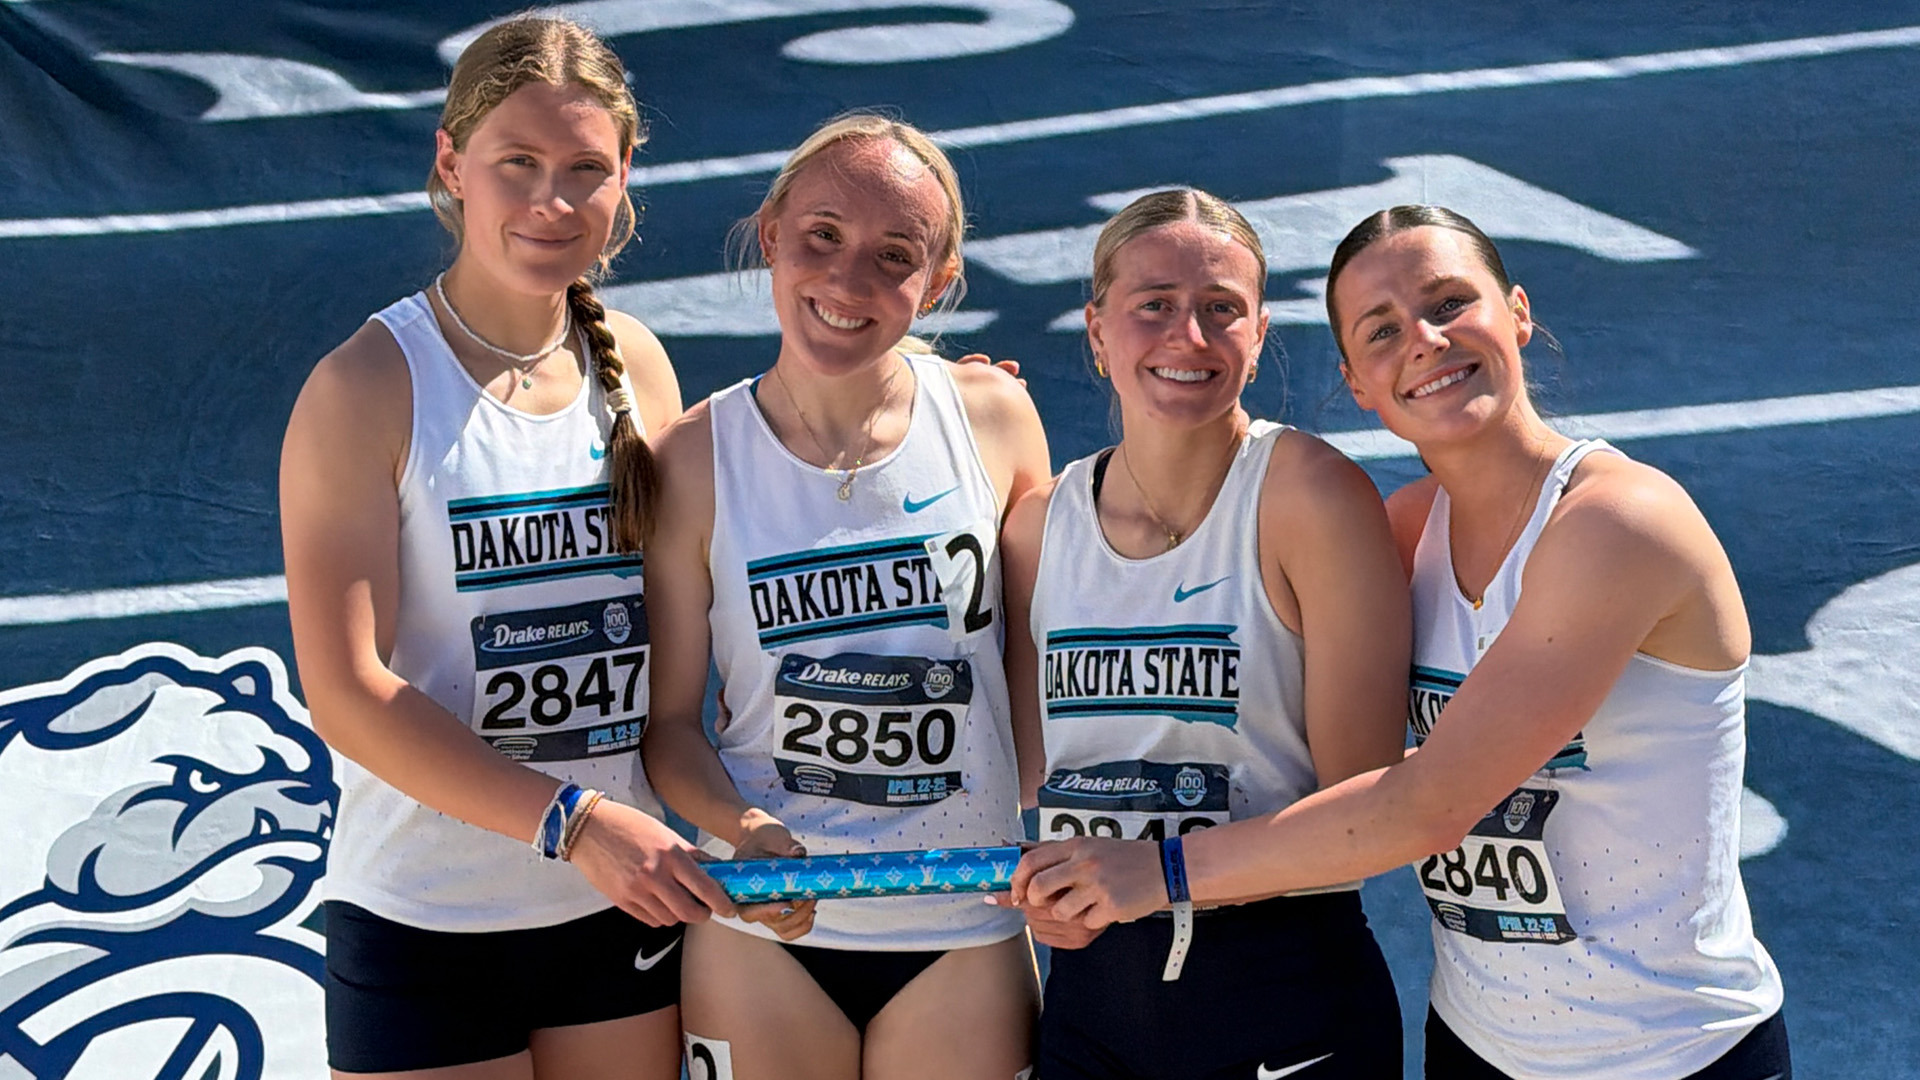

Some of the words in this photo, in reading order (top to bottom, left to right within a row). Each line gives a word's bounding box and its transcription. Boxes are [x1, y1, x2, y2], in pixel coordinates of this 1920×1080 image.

[450, 510, 580, 573] DAKOTA
[749, 563, 888, 630] DAKOTA
[944, 532, 993, 634] 2
[493, 622, 546, 648] Drake
[547, 620, 590, 639] RELAYS
[606, 612, 626, 628] 100
[481, 651, 646, 731] 2847
[797, 662, 862, 687] Drake
[862, 672, 911, 688] RELAYS
[929, 672, 951, 685] 100
[1046, 649, 1137, 700] DAKOTA
[1143, 646, 1241, 699] STATE
[782, 703, 956, 767] 2850
[1058, 773, 1114, 792] Drake
[1113, 777, 1158, 793] RELAYS
[1179, 776, 1202, 789] 100
[1510, 801, 1531, 815] 100
[1420, 843, 1549, 905] 2840
